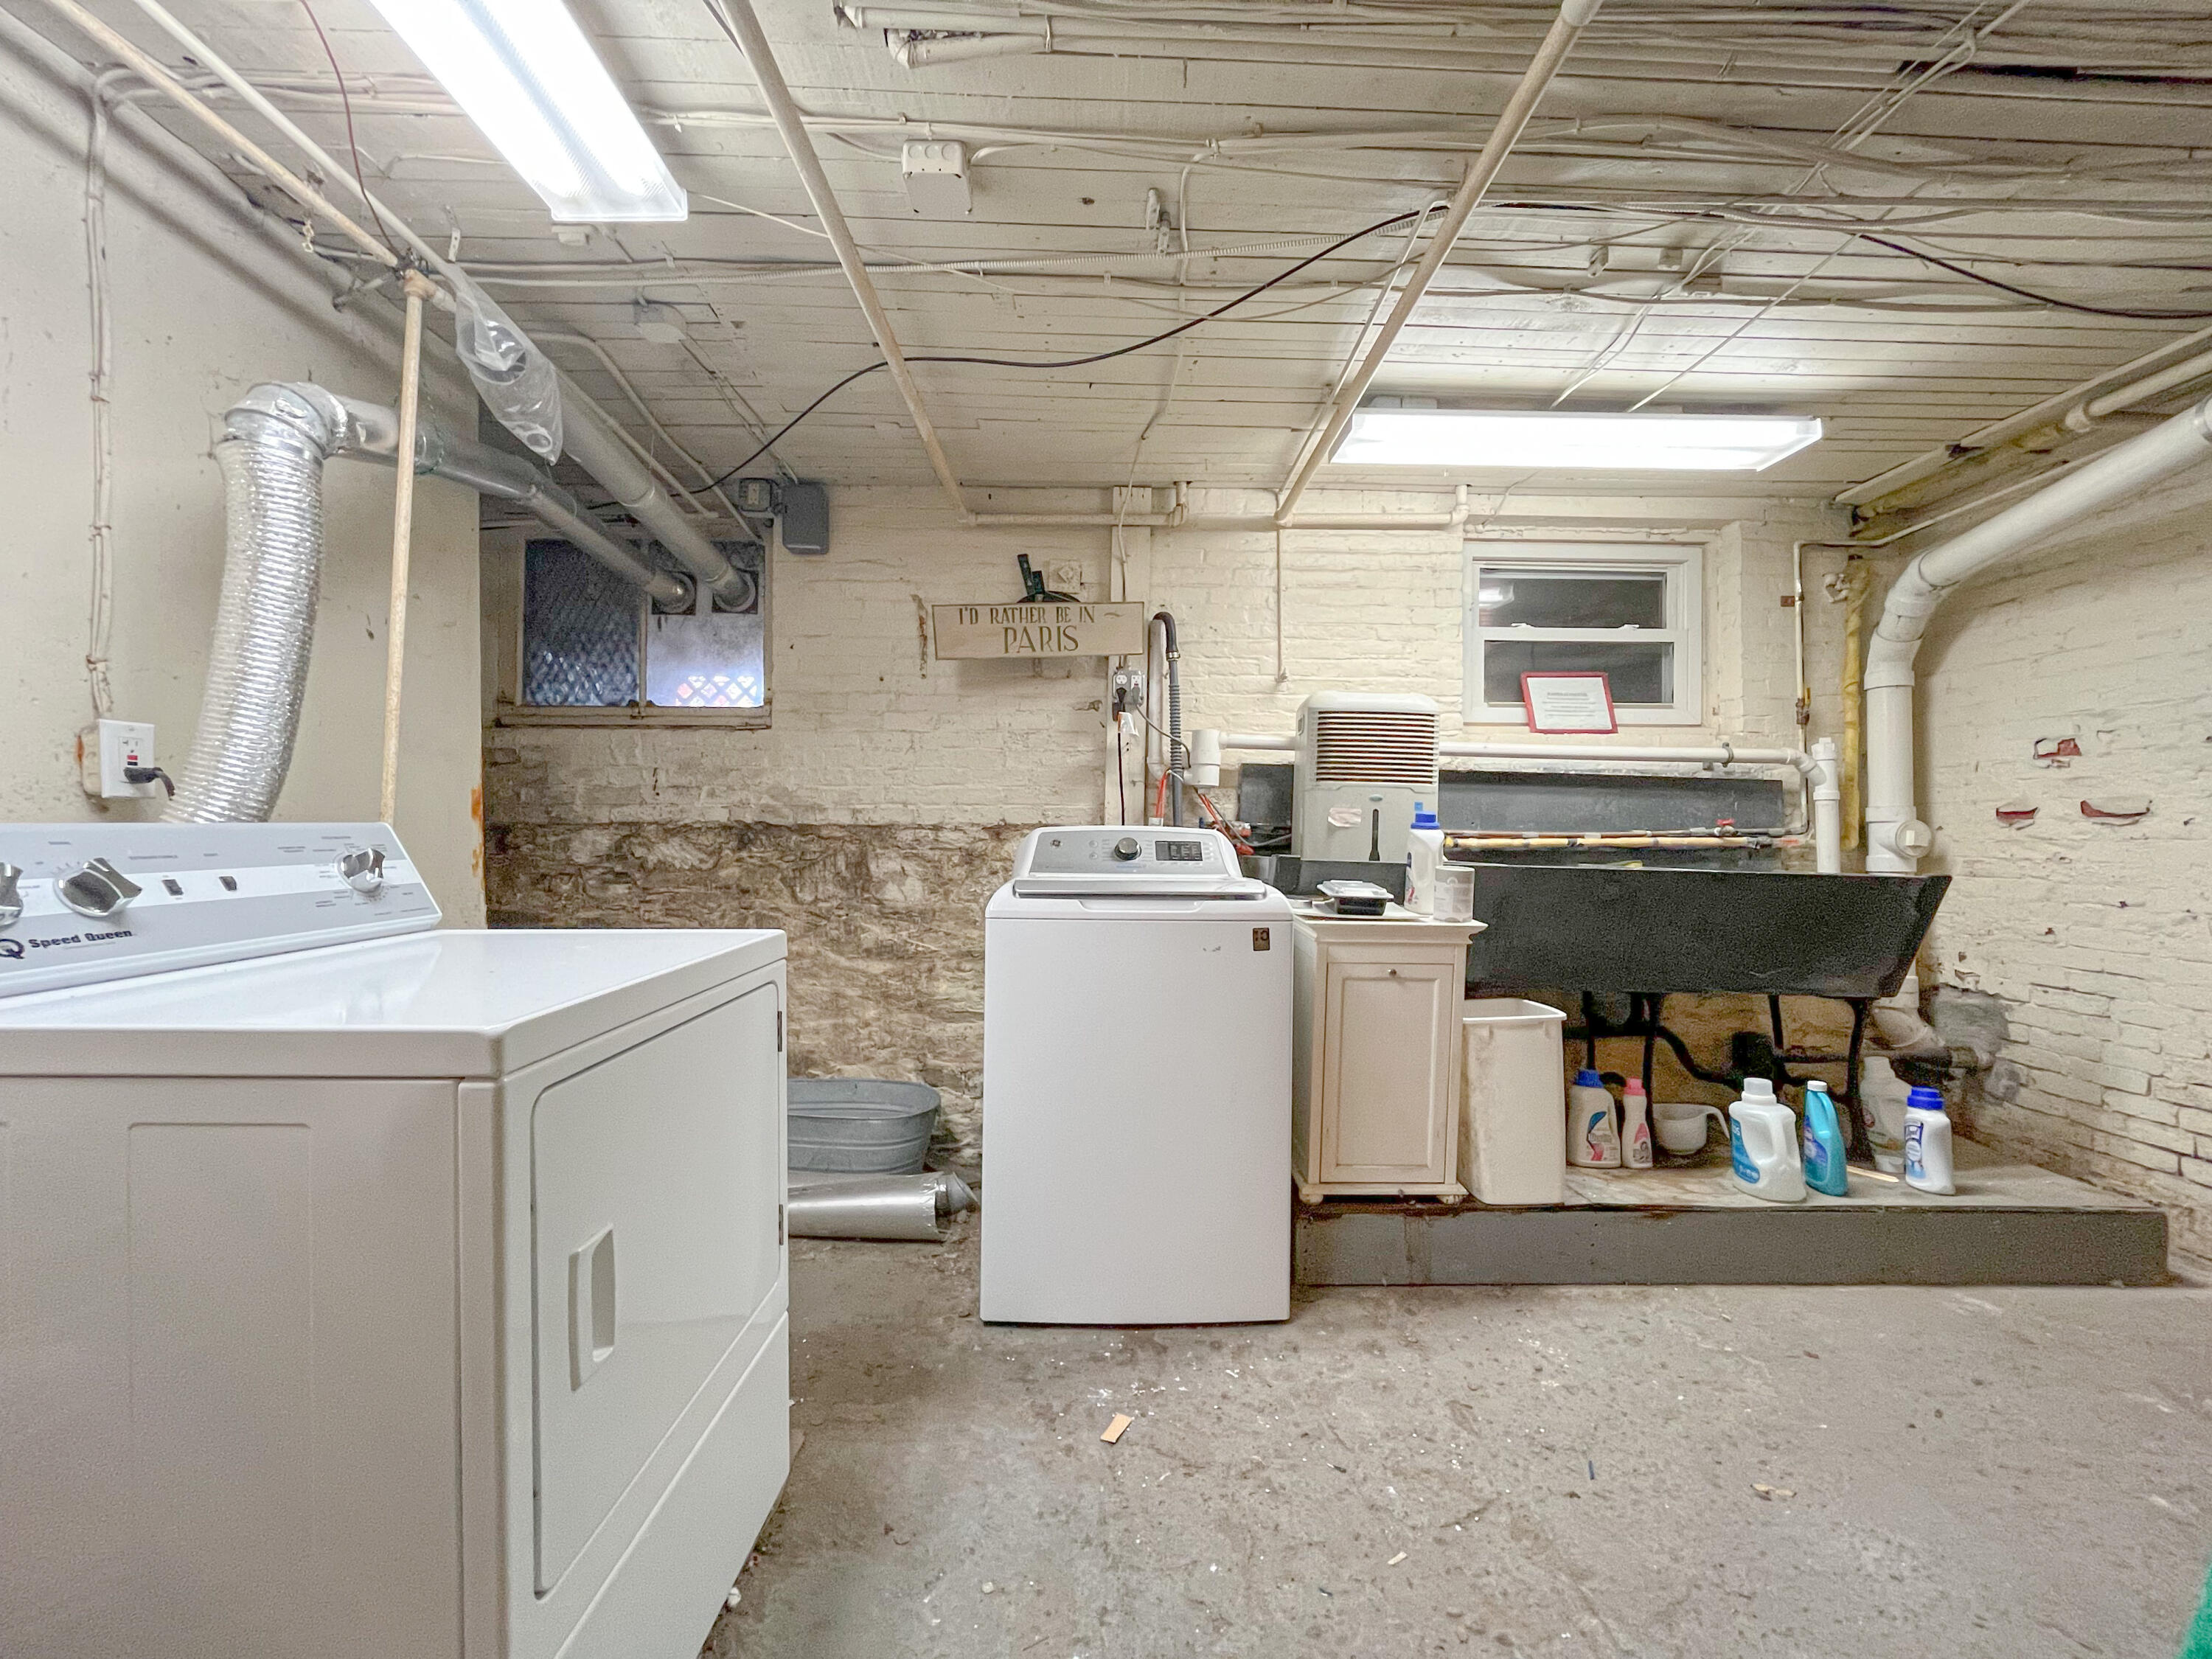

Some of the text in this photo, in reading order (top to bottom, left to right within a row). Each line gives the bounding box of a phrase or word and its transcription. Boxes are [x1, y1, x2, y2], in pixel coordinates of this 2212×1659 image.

[959, 605, 1095, 625] I'D RATHER BE IN
[1003, 625, 1079, 654] PARIS
[28, 934, 81, 949] Speed
[84, 930, 133, 942] Queen
